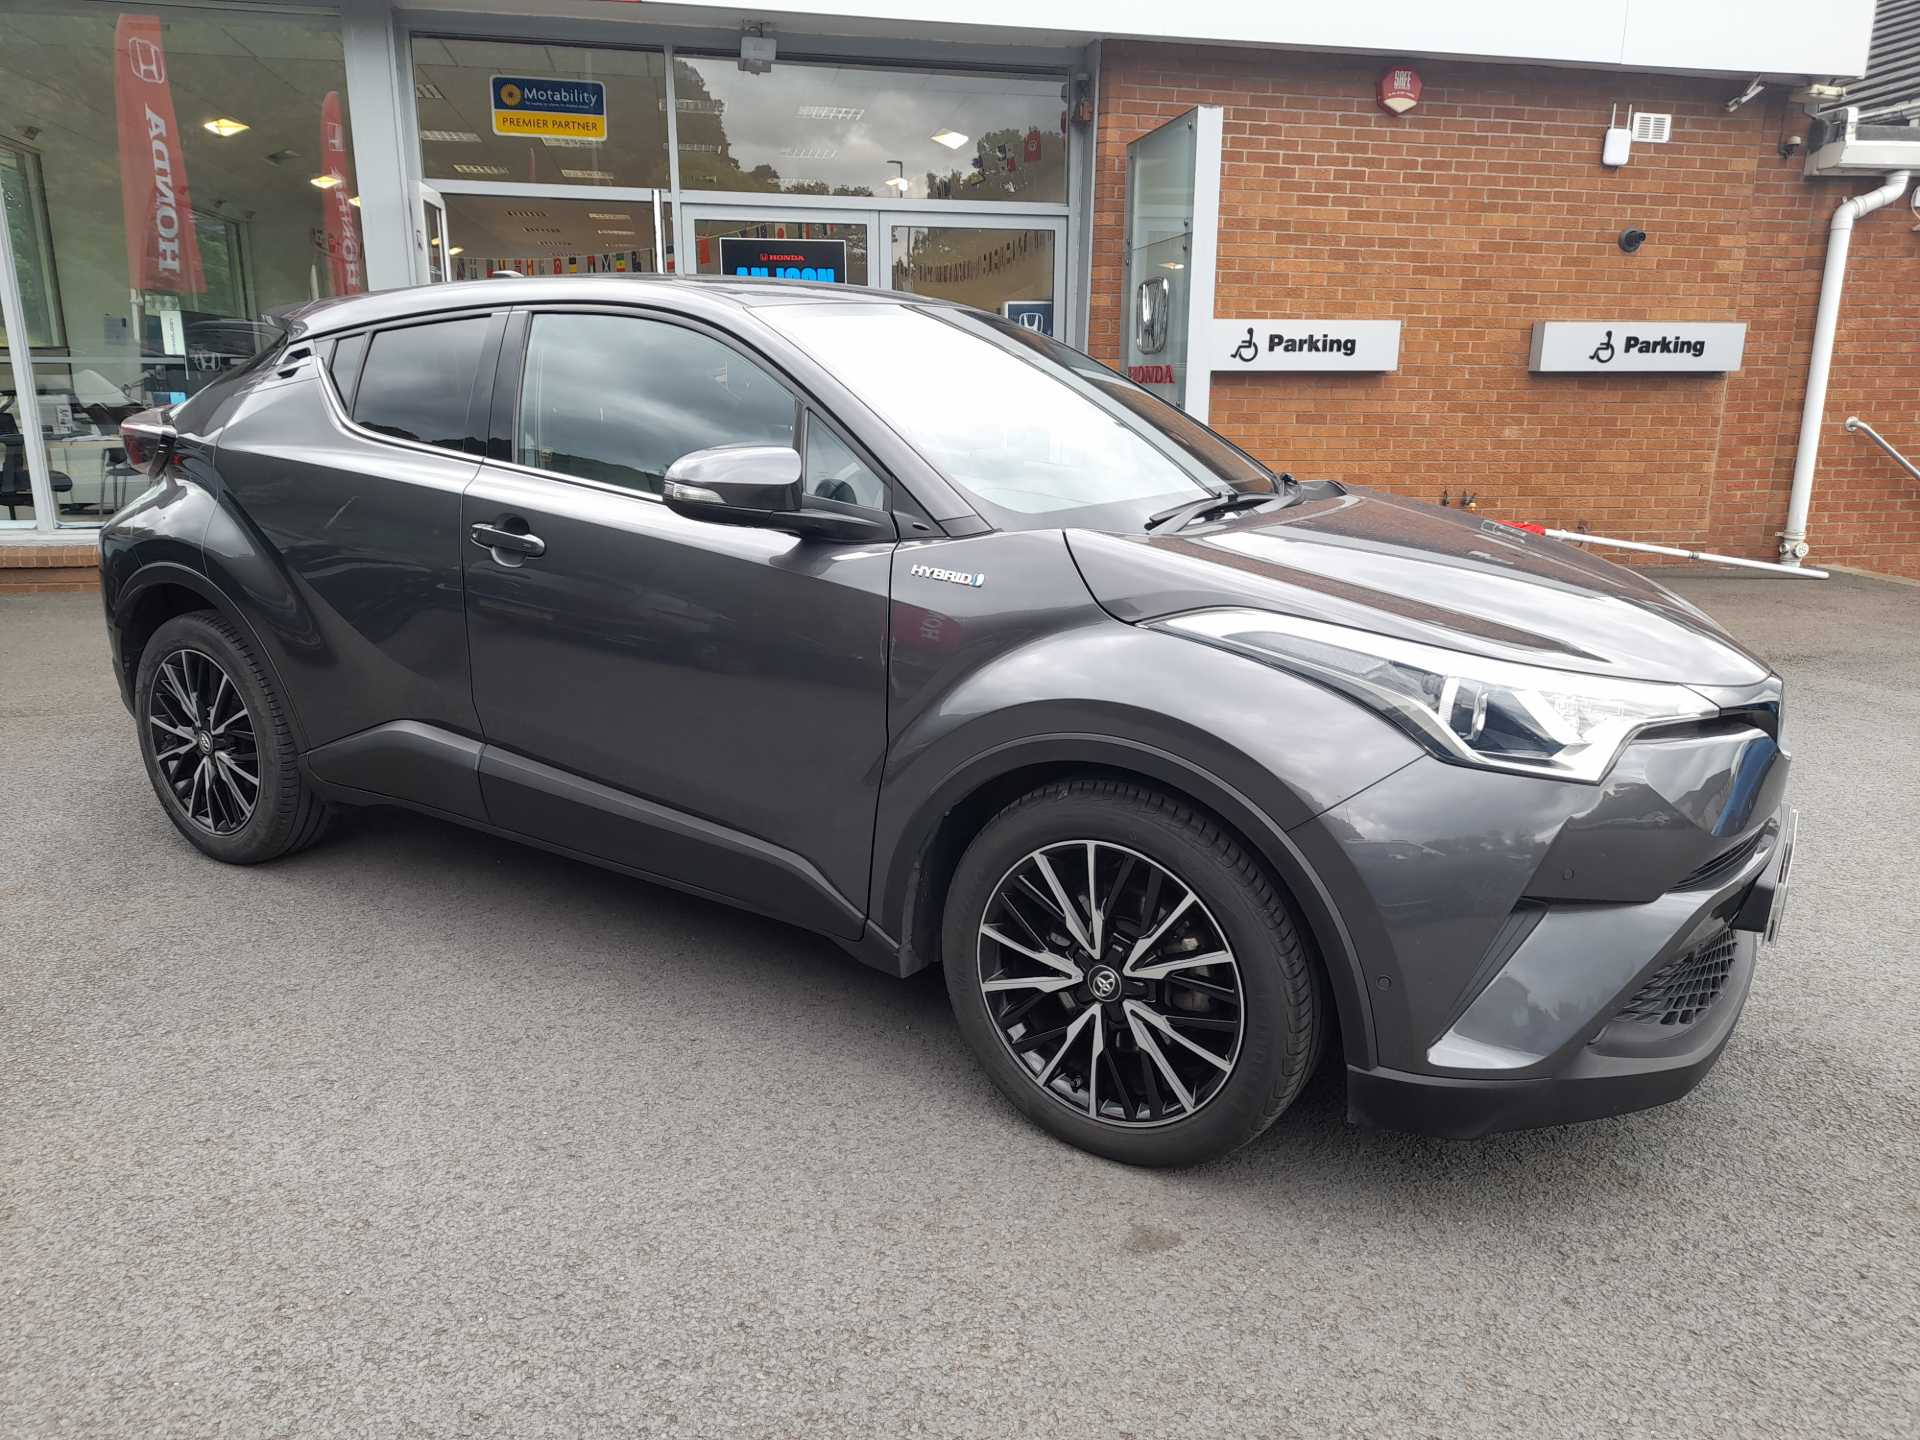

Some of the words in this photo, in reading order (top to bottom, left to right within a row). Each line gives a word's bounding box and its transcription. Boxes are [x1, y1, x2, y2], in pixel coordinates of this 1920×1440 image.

[524, 87, 598, 107] Motability
[502, 117, 549, 129] PREMIER
[552, 119, 598, 132] PARTNER
[769, 253, 806, 261] HONDA
[1268, 333, 1357, 357] Parking
[1624, 336, 1705, 358] Parking
[910, 564, 972, 586] HYBRID
